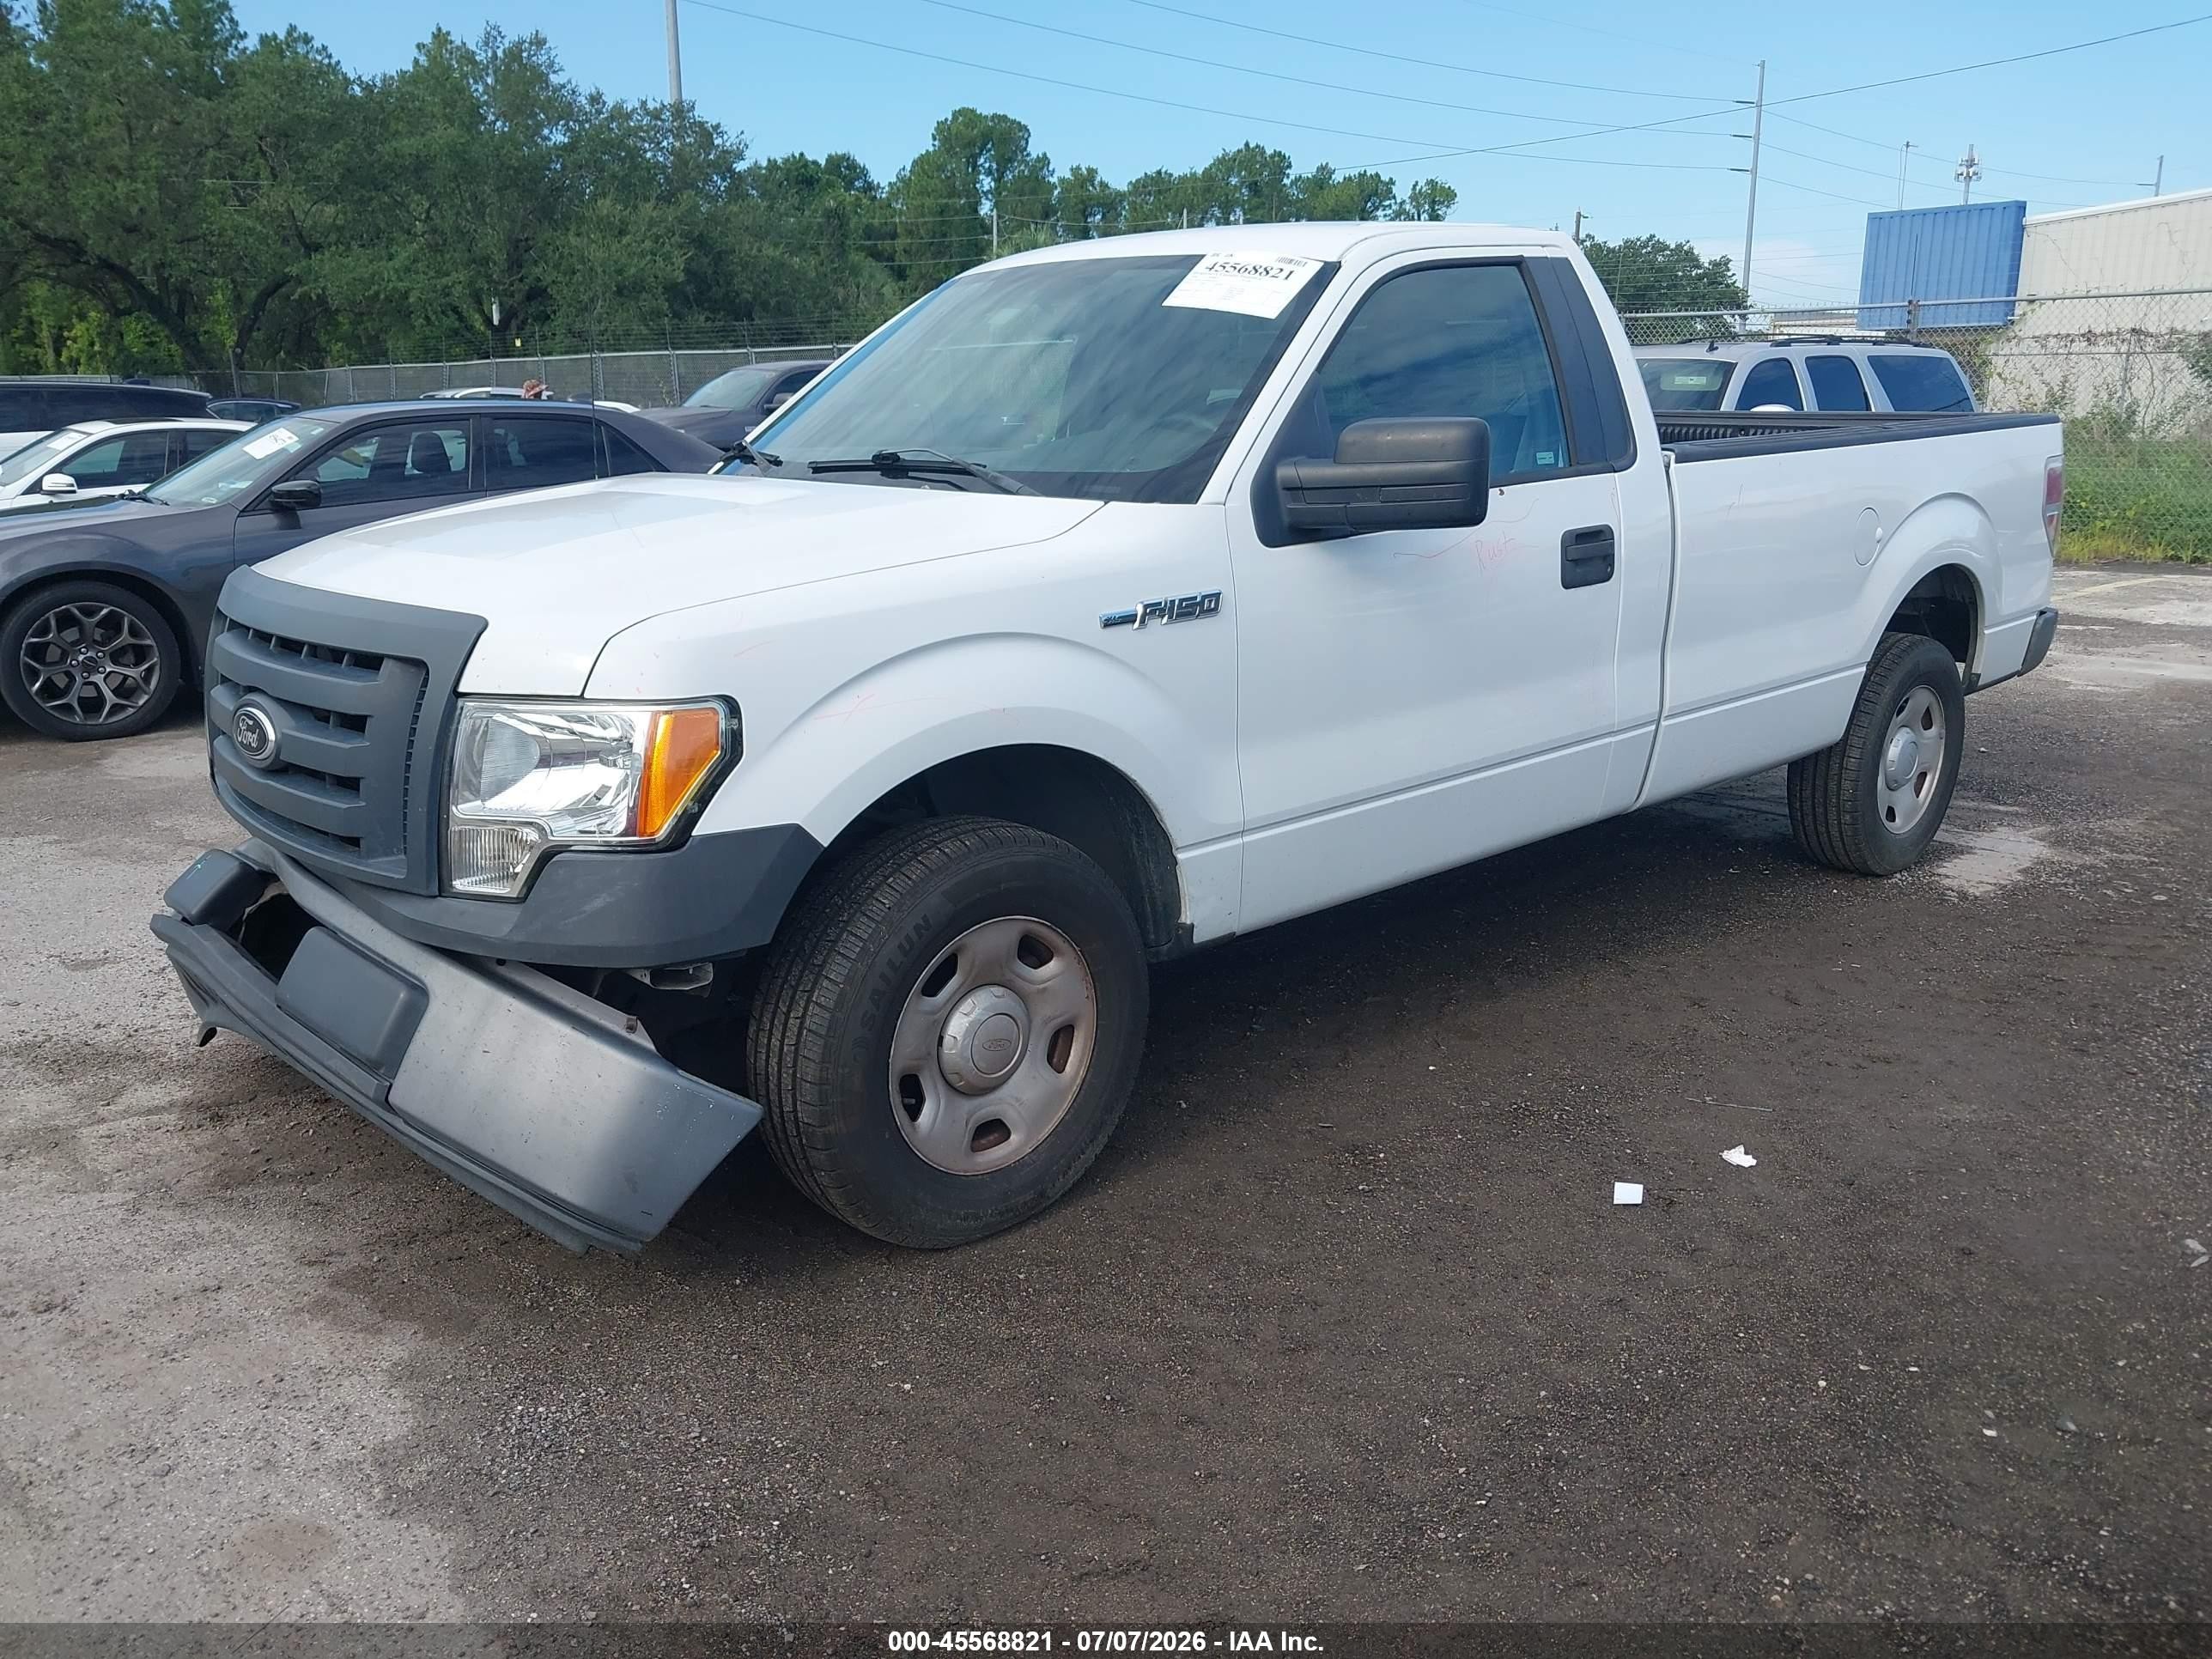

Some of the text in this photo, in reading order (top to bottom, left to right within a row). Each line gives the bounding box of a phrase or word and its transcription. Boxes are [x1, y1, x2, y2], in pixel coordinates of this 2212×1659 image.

[1205, 261, 1294, 281] 45568821
[237, 715, 259, 748] Ford
[860, 913, 933, 1032] SAILUN
